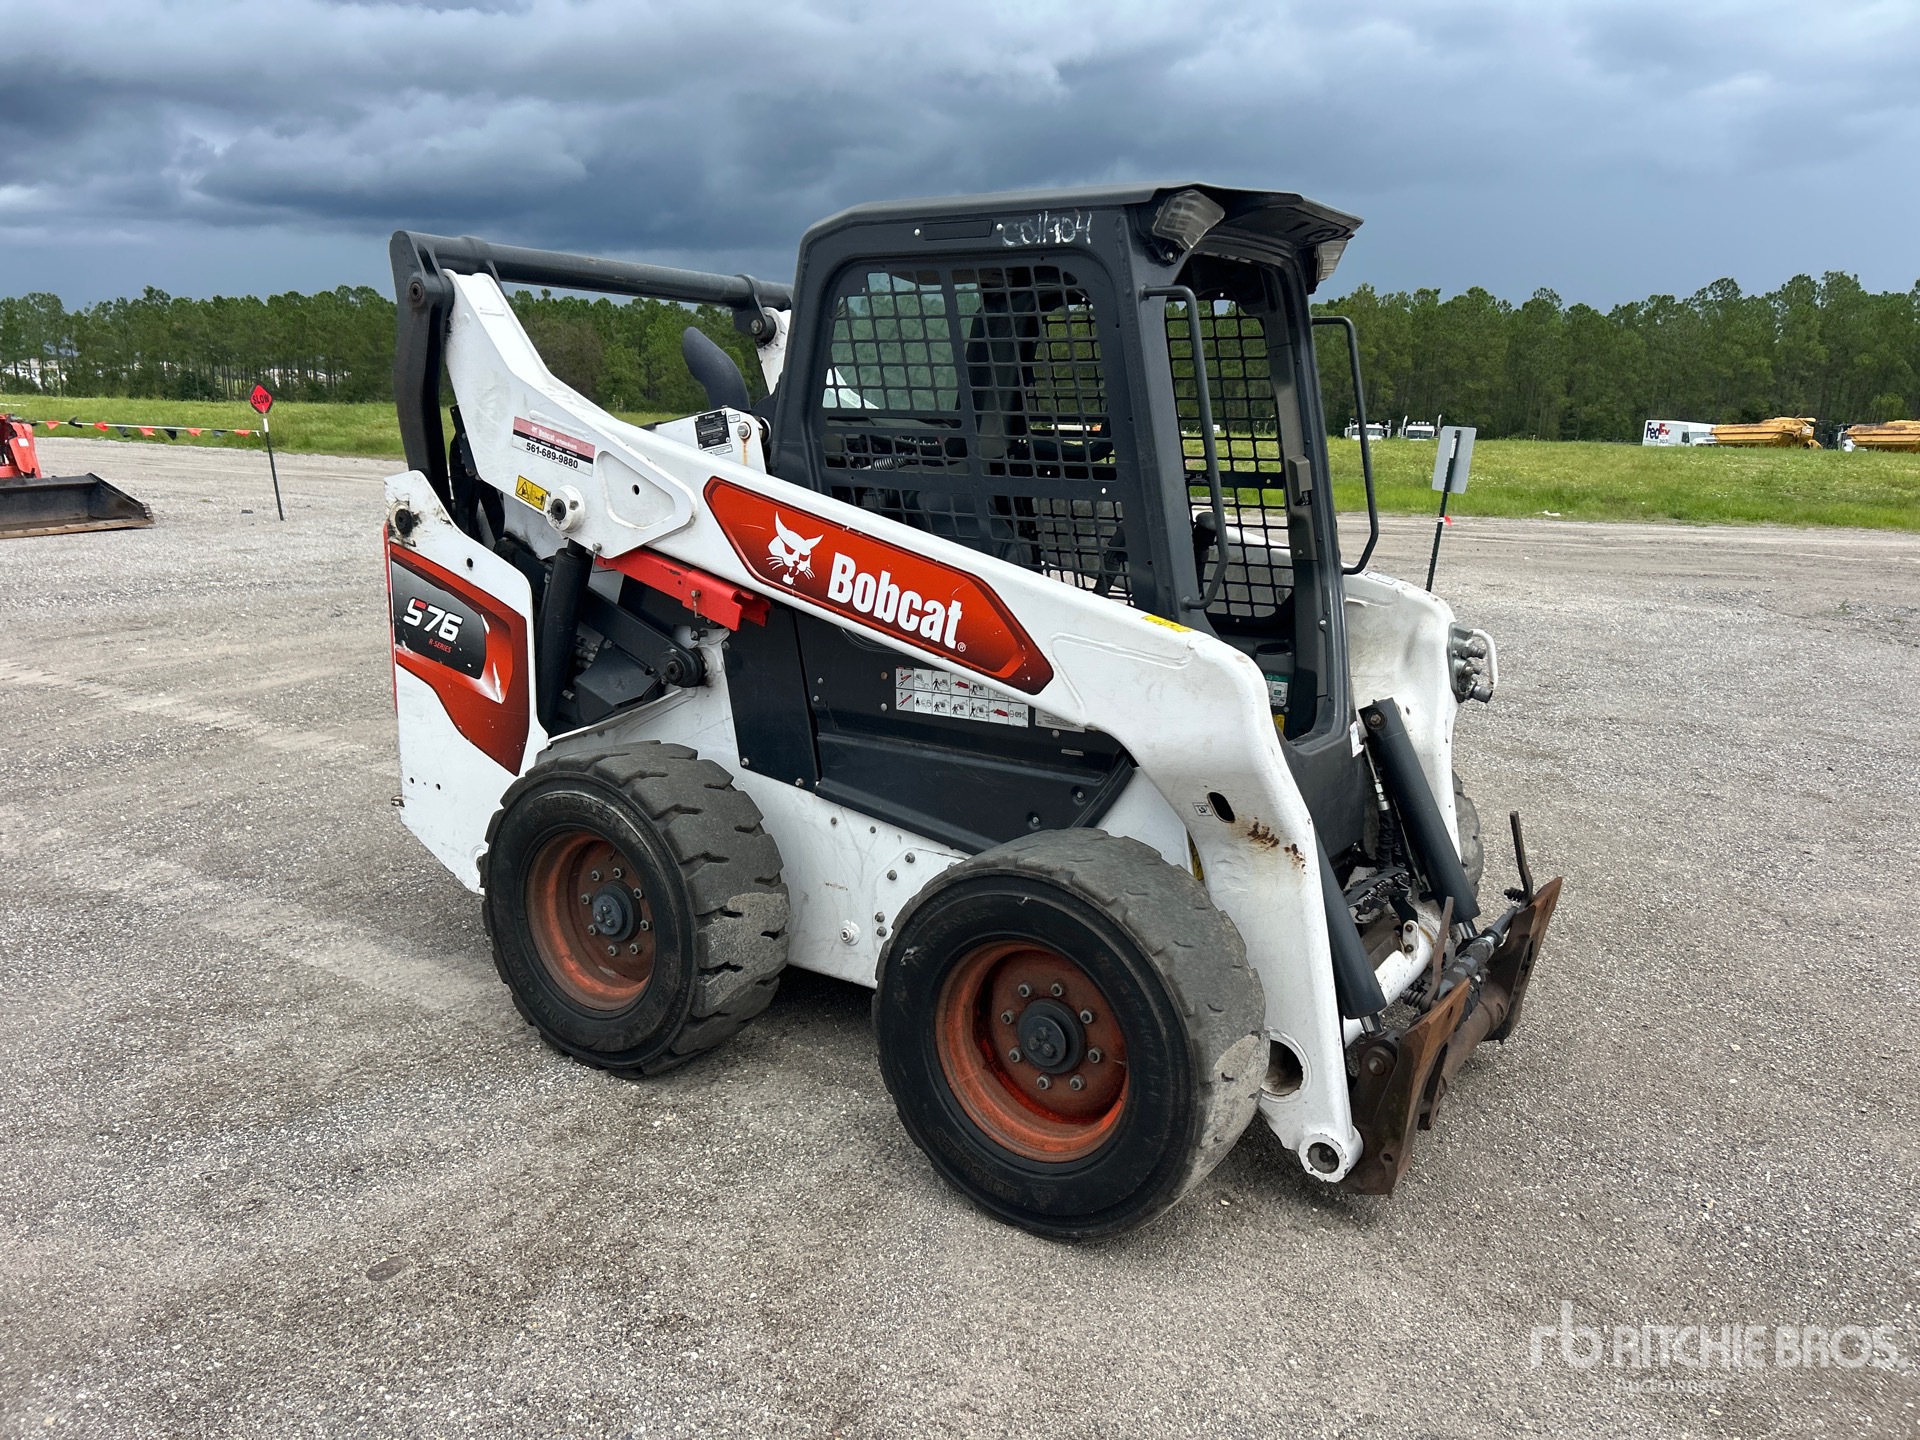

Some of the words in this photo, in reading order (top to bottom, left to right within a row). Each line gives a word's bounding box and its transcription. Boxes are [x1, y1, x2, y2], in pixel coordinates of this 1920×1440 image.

[252, 394, 270, 405] SLOW
[525, 442, 579, 469] 561-689-9880
[827, 551, 963, 649] Bobcat
[402, 598, 464, 642] S76
[428, 638, 453, 654] R-SERIES
[935, 1126, 1020, 1201] HERCULES
